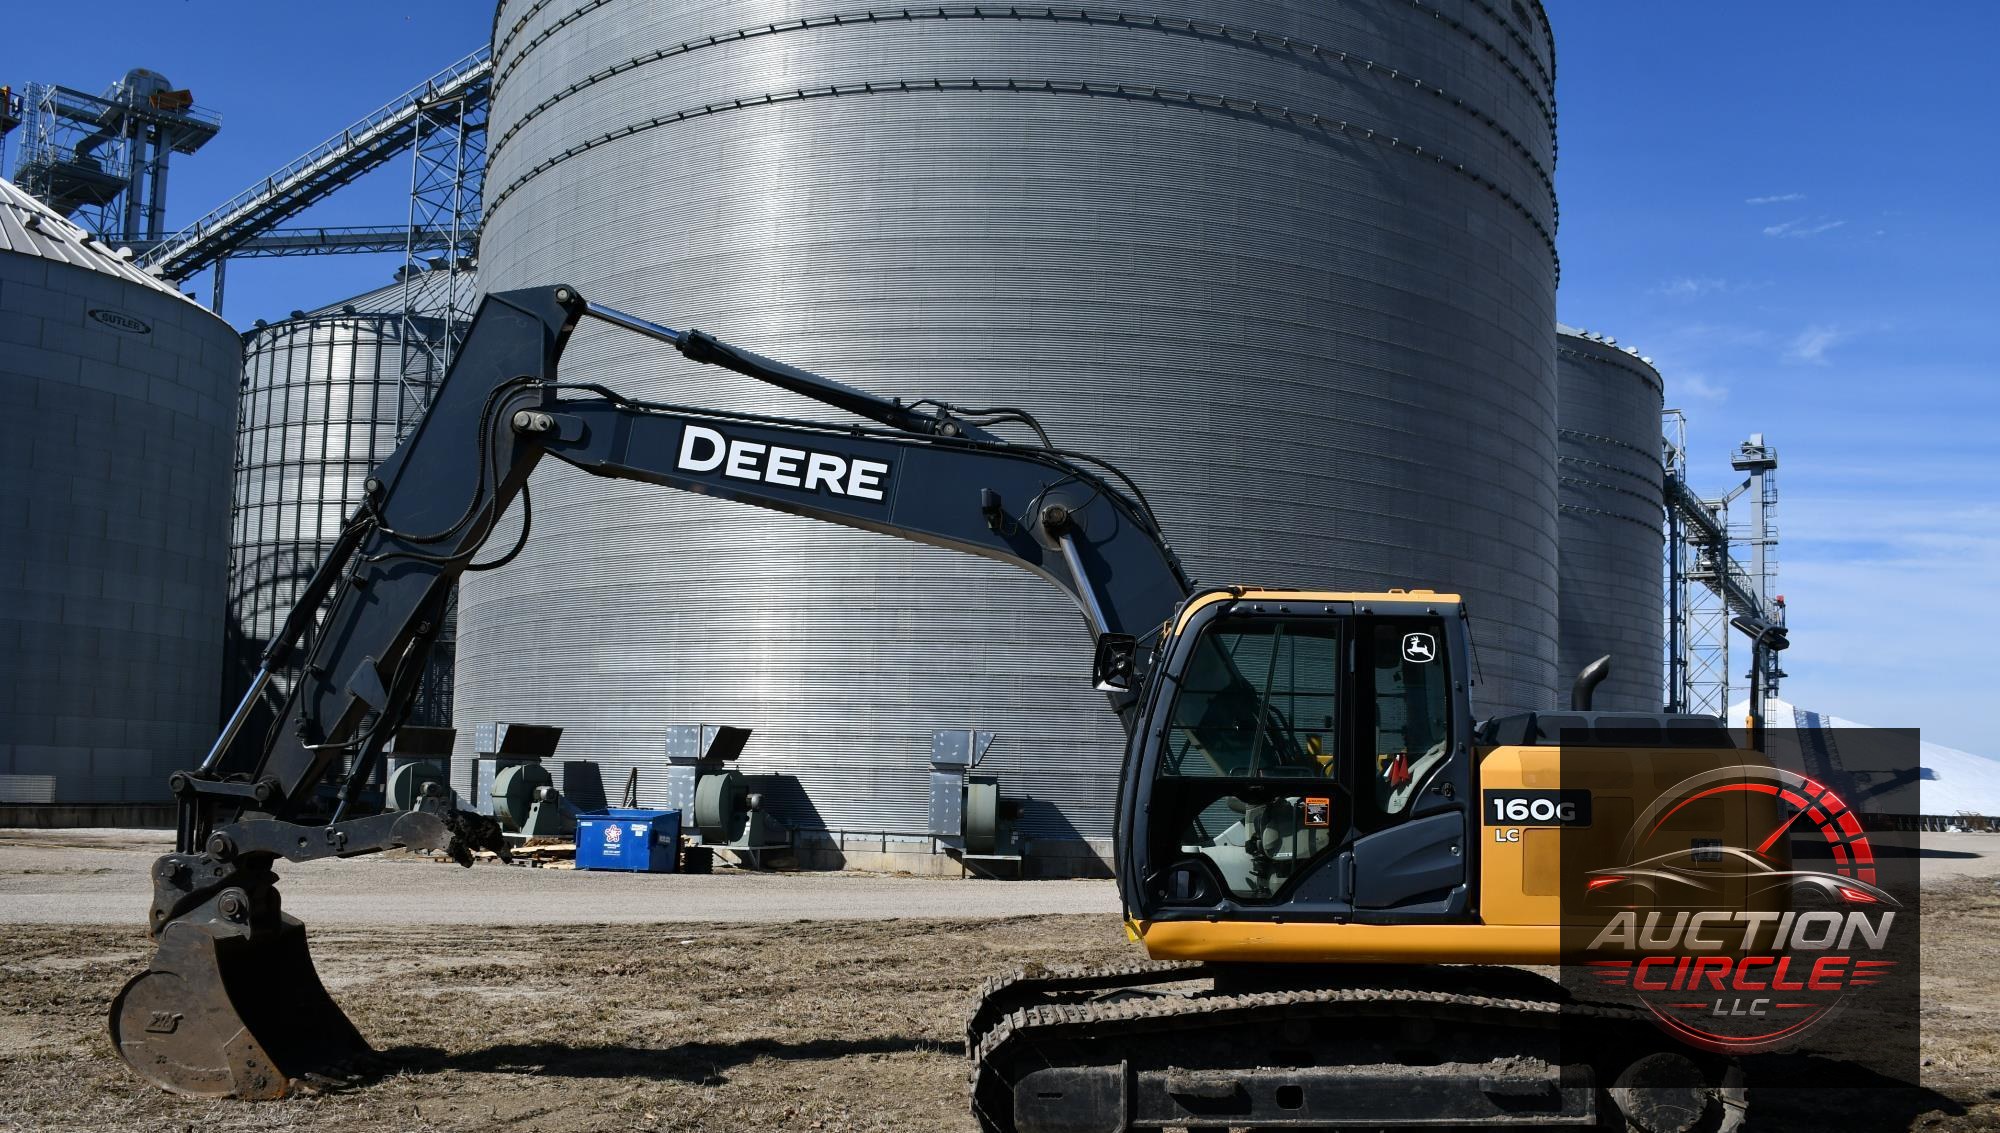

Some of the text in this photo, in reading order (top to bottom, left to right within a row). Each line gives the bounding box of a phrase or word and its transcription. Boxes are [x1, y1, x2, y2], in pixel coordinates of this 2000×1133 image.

[101, 312, 140, 331] BUTLER
[678, 424, 888, 500] DEERE
[1493, 798, 1576, 821] 160G
[1495, 829, 1519, 842] LC
